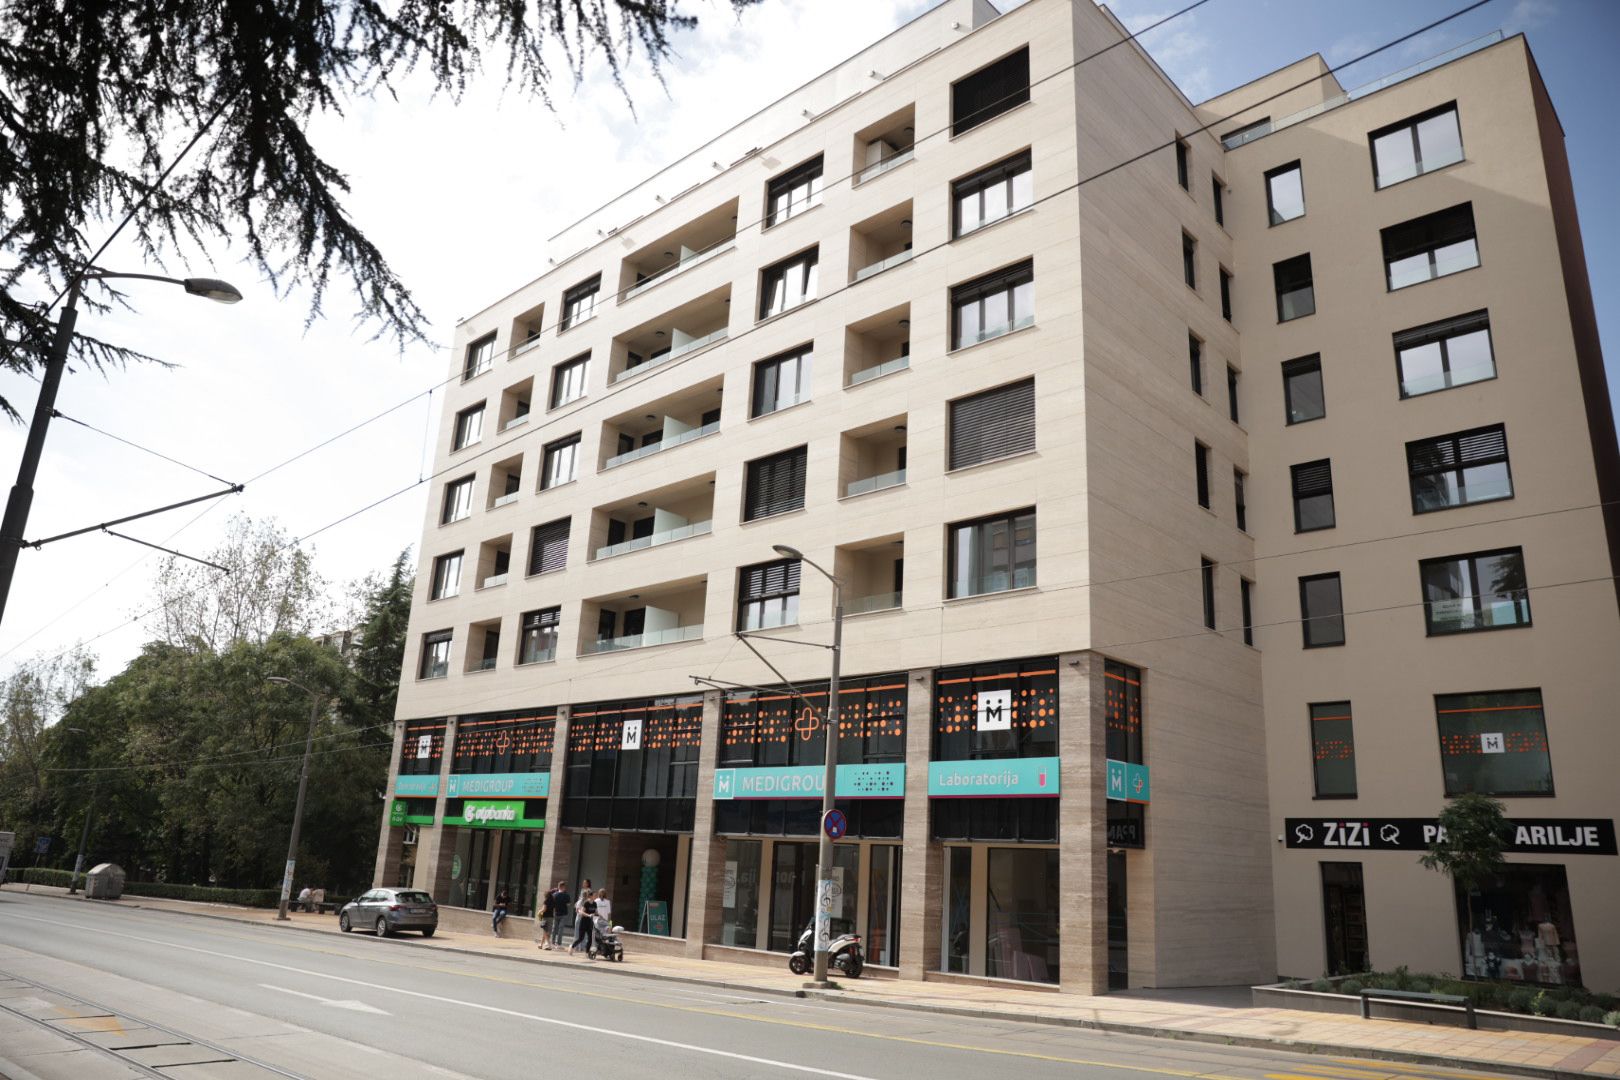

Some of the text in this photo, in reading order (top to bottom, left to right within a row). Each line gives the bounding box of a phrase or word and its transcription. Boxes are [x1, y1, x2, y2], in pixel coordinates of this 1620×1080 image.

[463, 779, 514, 793] MEDIGROUP
[742, 773, 825, 792] MEDIGROU
[939, 770, 1019, 788] Laboratorija
[1322, 822, 1371, 846] ZiZi
[1515, 825, 1600, 847] ARILJE
